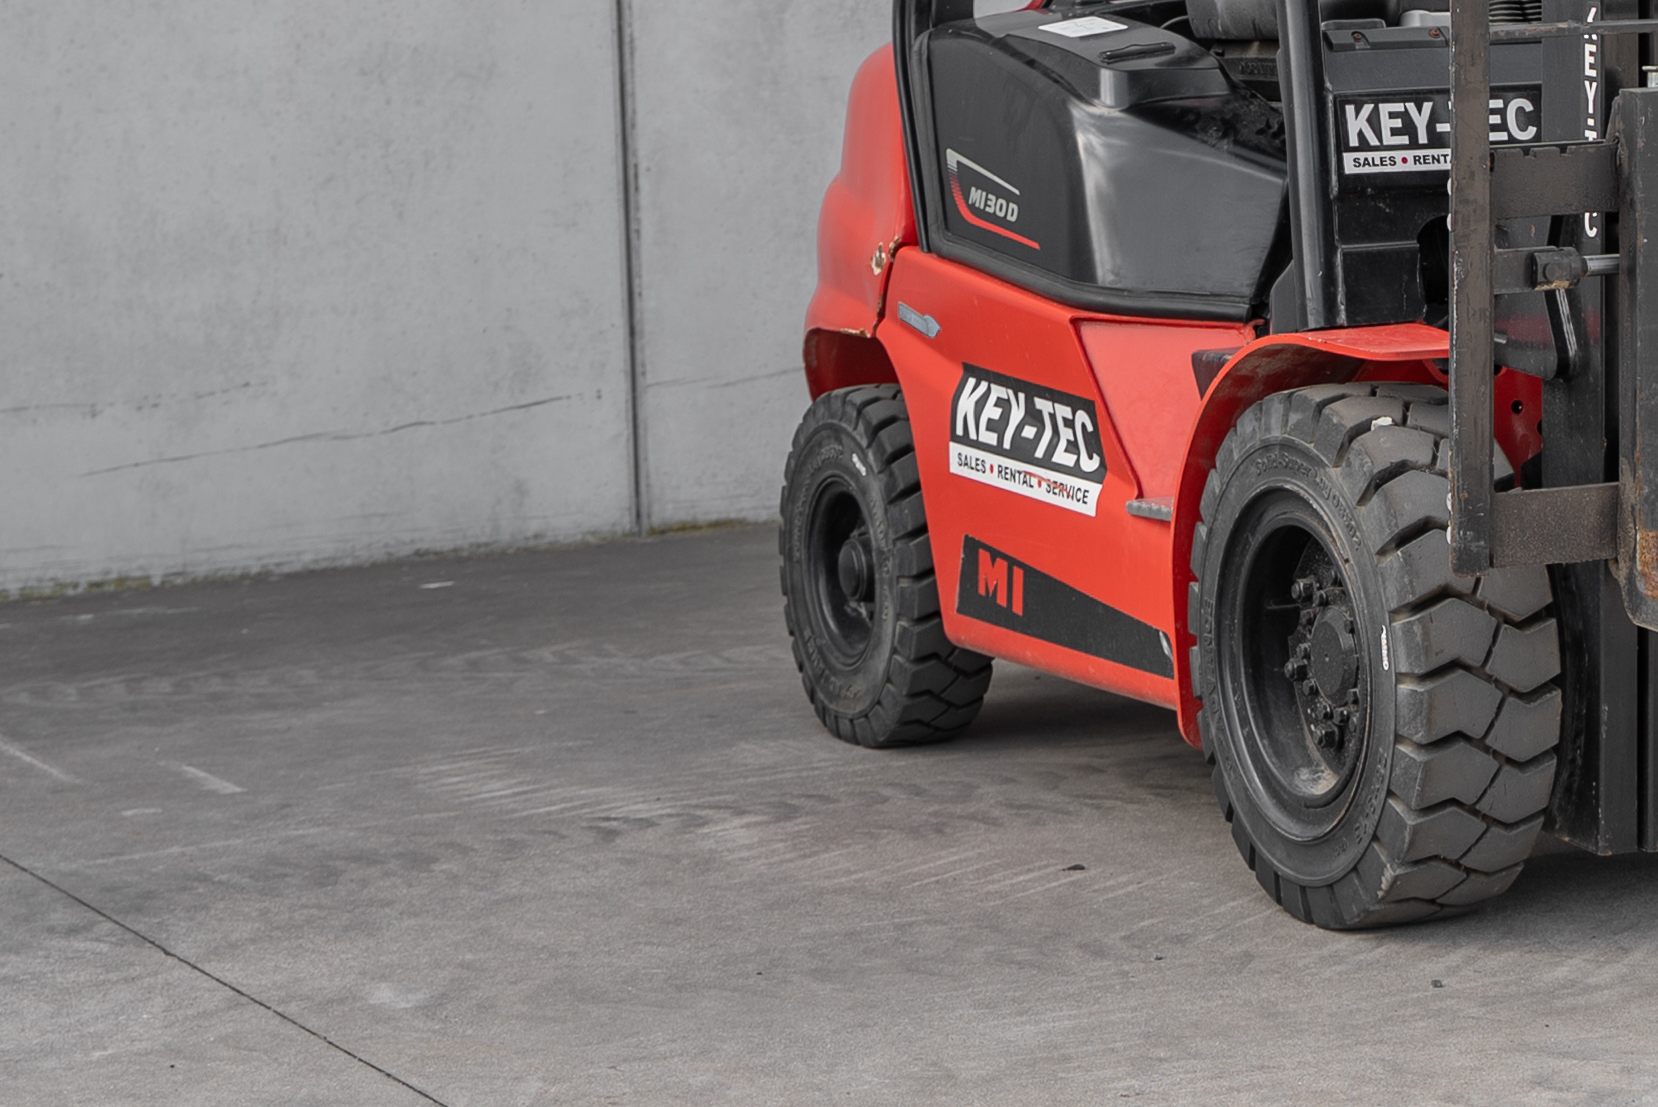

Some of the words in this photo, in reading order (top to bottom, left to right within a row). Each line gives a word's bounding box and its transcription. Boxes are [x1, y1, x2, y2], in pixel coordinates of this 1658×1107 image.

[1345, 98, 1537, 147] KEY-EC
[1352, 155, 1397, 168] SALES
[1413, 153, 1451, 165] RENT
[955, 376, 1101, 473] KEY-TEC
[957, 452, 987, 474] SALES
[997, 464, 1034, 489] RENTAL
[1045, 478, 1090, 505] SERVICE
[977, 547, 1024, 617] MI
